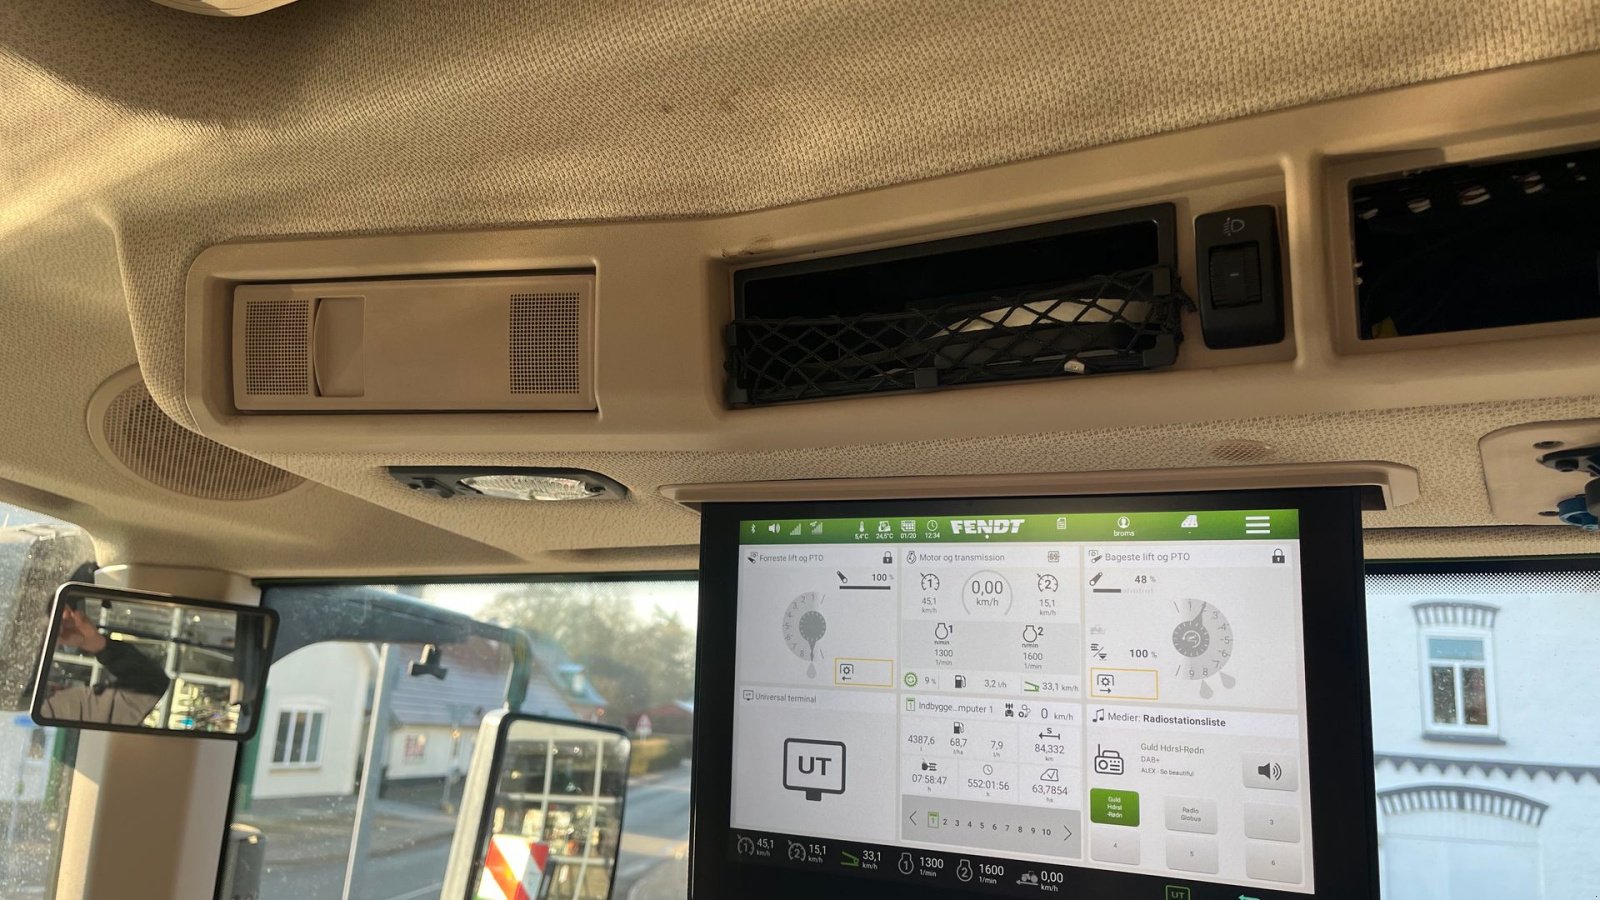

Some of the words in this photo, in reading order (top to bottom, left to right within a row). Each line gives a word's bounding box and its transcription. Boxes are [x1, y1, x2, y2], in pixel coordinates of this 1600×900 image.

[950, 519, 1025, 534] FENDT
[1113, 529, 1135, 537] broms
[759, 554, 787, 562] Forreste
[788, 554, 797, 562] lift
[798, 555, 808, 563] og
[808, 554, 824, 562] PTO
[919, 552, 943, 562] Motor
[944, 554, 954, 564] og
[954, 553, 1005, 562] transmission
[1105, 552, 1141, 563] Bageste
[1142, 552, 1155, 562] lift
[1157, 554, 1169, 564] og
[1170, 552, 1191, 562] PTO
[872, 573, 887, 582] 100
[1134, 575, 1147, 584] 48
[928, 579, 933, 588] 1
[971, 580, 1003, 597] 0,00
[1044, 579, 1052, 590] 2
[921, 597, 937, 606] 45,1
[976, 598, 999, 607] km/h
[1039, 599, 1056, 608] 15,1
[921, 607, 938, 615] km/h
[1039, 609, 1056, 617] km/h
[948, 625, 954, 634] 1
[1037, 627, 1044, 636] 2
[934, 649, 953, 657] 1300
[1023, 652, 1043, 661] 1600
[1130, 649, 1148, 658] 100
[924, 676, 930, 685] 9
[984, 679, 997, 689] 3,2
[1042, 682, 1060, 692] 33,1
[1061, 684, 1079, 693] km/h
[755, 691, 787, 702] Universal
[788, 694, 817, 704] terminal
[988, 705, 994, 713] 1
[1041, 708, 1049, 719] 0
[1053, 713, 1074, 721] km/h
[1107, 712, 1141, 723] Medier:
[1143, 714, 1227, 728] Radiostationsliste
[908, 735, 935, 746] 4387,6
[950, 738, 968, 748] 68,7
[990, 740, 1004, 751] 7,9
[1034, 743, 1065, 755] 84,332
[1140, 743, 1158, 752] Guld
[798, 755, 832, 776] UT
[911, 774, 948, 785] 07:58:47
[967, 779, 1010, 791] 552:01:56
[1032, 784, 1068, 796] 63,7854
[943, 818, 948, 826] 2
[955, 819, 960, 827] 3
[967, 821, 973, 829] 4
[980, 822, 985, 830] 5
[1017, 826, 1023, 834] 8
[1030, 827, 1036, 835] 9
[1042, 828, 1051, 836] 10
[756, 838, 774, 849] 45,1
[794, 849, 801, 858] 2
[809, 844, 827, 855] 15,1
[862, 850, 881, 862] 33,1
[862, 862, 878, 870] km/h
[903, 860, 909, 870] 1
[919, 857, 944, 868] 1300
[919, 868, 937, 877] 1/min
[961, 867, 969, 878] 2
[979, 863, 1004, 876] 1600
[978, 876, 997, 884] 1/min
[1040, 871, 1064, 883] 0,00
[1040, 884, 1059, 892] km/h
[1171, 891, 1185, 899] UT
